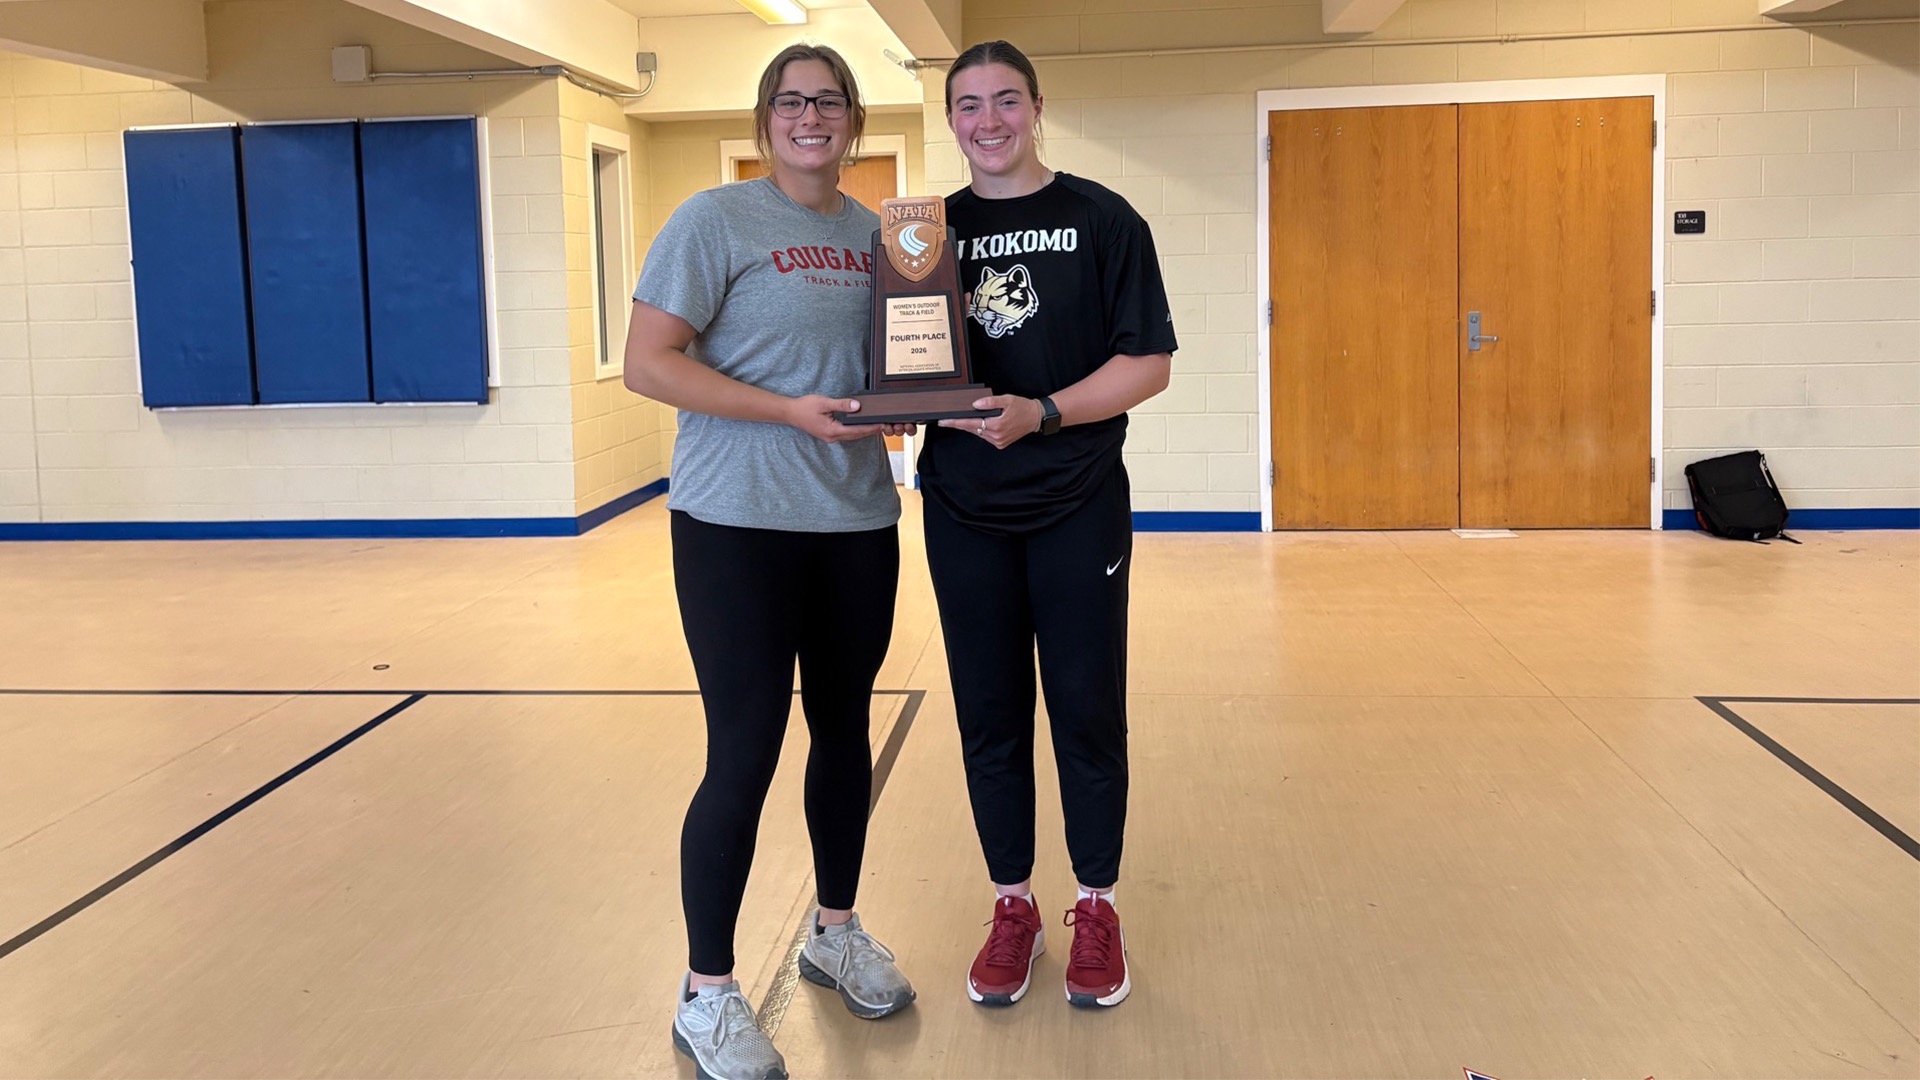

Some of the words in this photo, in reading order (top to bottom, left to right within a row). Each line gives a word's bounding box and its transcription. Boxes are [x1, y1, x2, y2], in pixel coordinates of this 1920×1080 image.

[888, 204, 938, 226] NAIA
[971, 228, 1077, 260] KOKOMO
[803, 276, 840, 287] TRACK
[890, 334, 920, 342] FOURTH
[922, 332, 947, 341] PLACE
